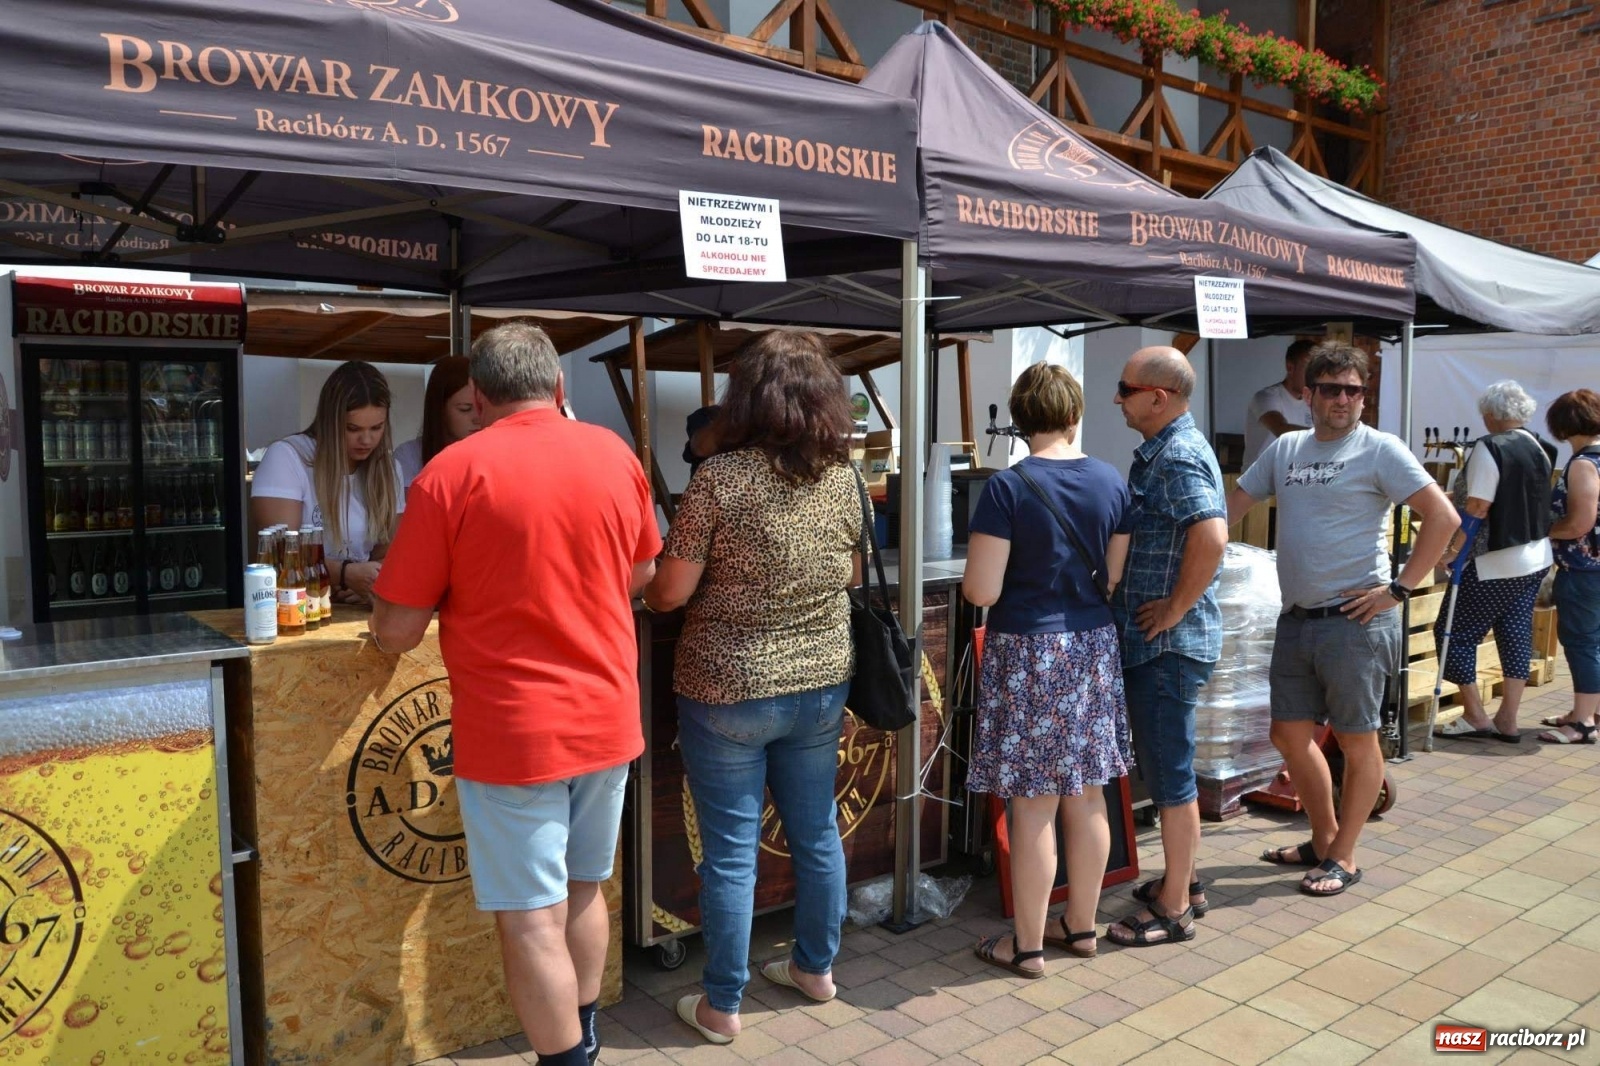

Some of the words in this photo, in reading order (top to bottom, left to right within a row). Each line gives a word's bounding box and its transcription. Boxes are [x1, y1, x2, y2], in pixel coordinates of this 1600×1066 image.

[101, 32, 357, 100] BROWAR
[369, 63, 619, 148] ZAMKOWY
[255, 108, 375, 142] Racibórz
[455, 130, 511, 158] 1567
[702, 123, 897, 184] RACIBORSKIE
[700, 216, 762, 230] MŁODZIEŻY
[957, 194, 1099, 238] RACIBORSKIE
[696, 232, 711, 243] DO
[713, 233, 735, 245] LAT
[738, 236, 768, 247] 18-TU
[1129, 210, 1215, 248] BROWAR
[1219, 221, 1309, 274] ZAMKOWY
[700, 250, 749, 262] ALKOHOLU
[751, 253, 766, 263] NIE
[702, 264, 767, 276] SPRZEDAJEMY
[1179, 251, 1221, 270] Racibórz
[1247, 262, 1267, 281] 1567
[1327, 254, 1405, 289] RACIBORSKIE
[73, 283, 129, 296] BROWAR
[130, 286, 195, 301] ZAMKOWY
[26, 306, 239, 338] RACIBORSKIE
[362, 690, 441, 772] BROWAR
